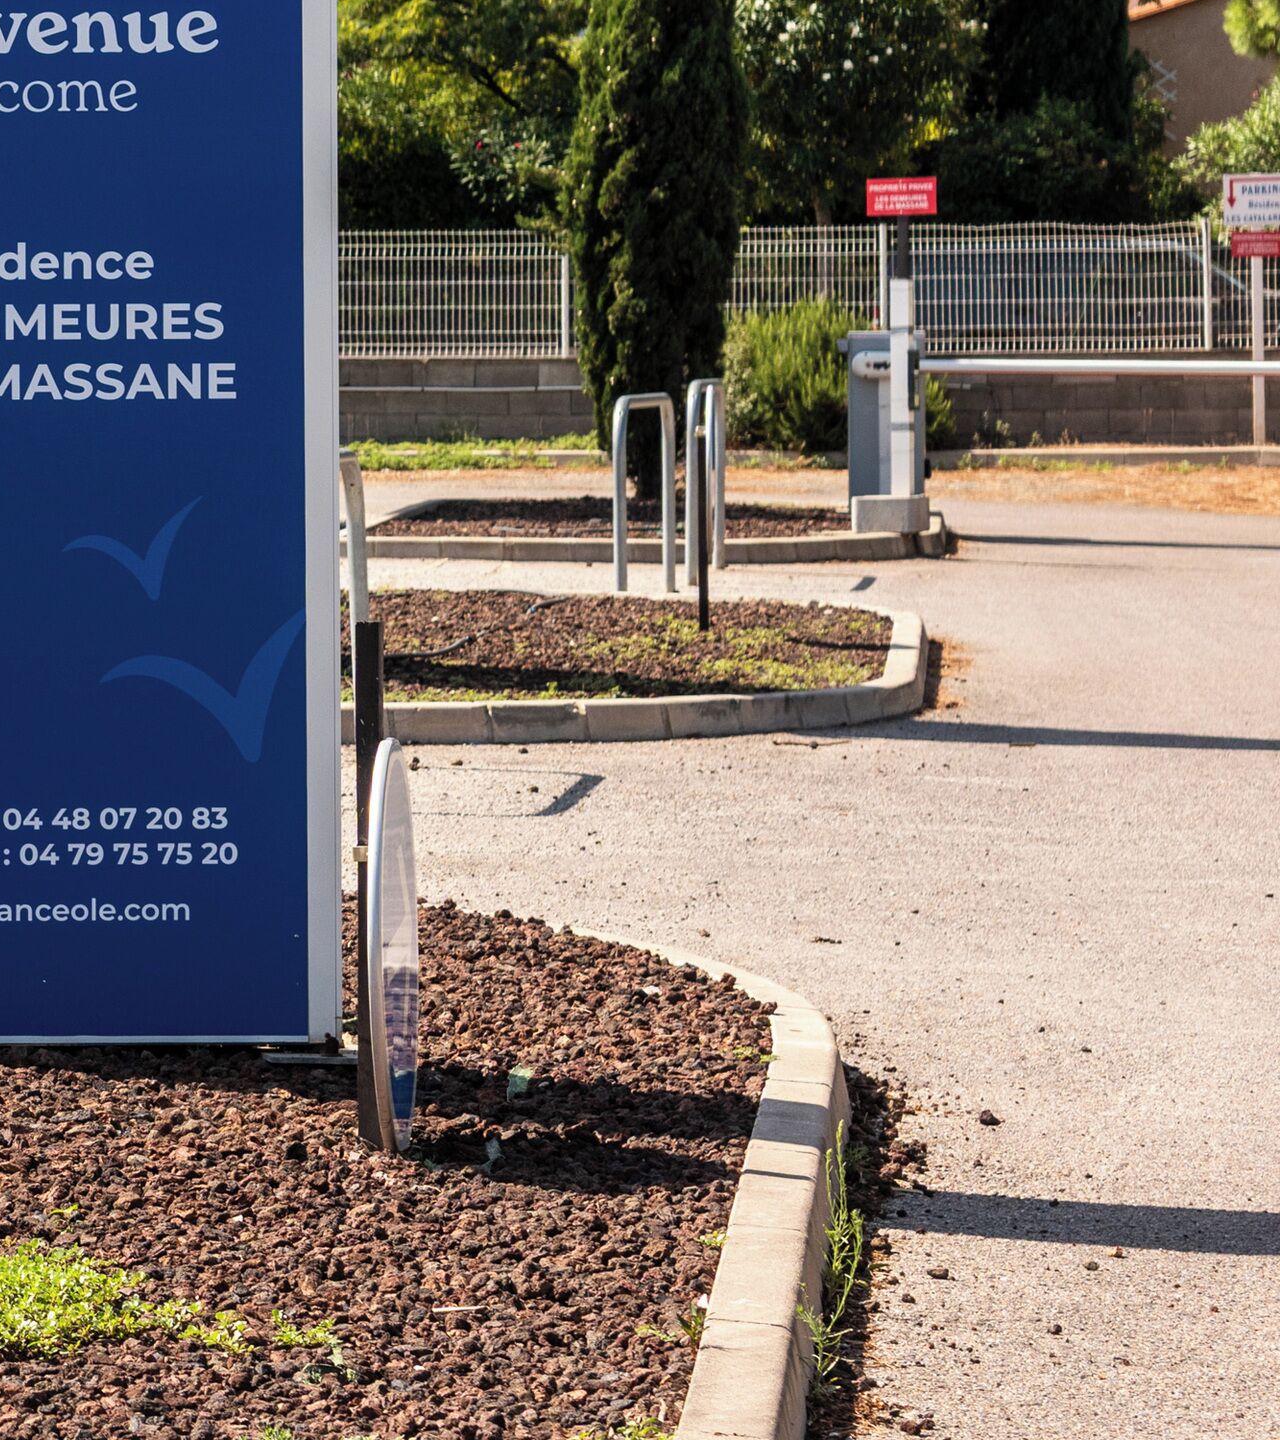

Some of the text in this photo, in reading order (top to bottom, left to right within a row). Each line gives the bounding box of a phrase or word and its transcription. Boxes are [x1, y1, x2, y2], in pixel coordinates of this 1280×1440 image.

[1241, 184, 1280, 195] PARKIN
[3, 807, 43, 830] 04
[51, 807, 91, 830] 48
[99, 807, 137, 830] 07
[145, 807, 183, 830] 20
[192, 807, 228, 830] 83
[19, 843, 60, 866] 04
[67, 843, 104, 866] 79
[113, 843, 149, 866] 75
[157, 843, 193, 866] 75
[201, 843, 238, 866] 20
